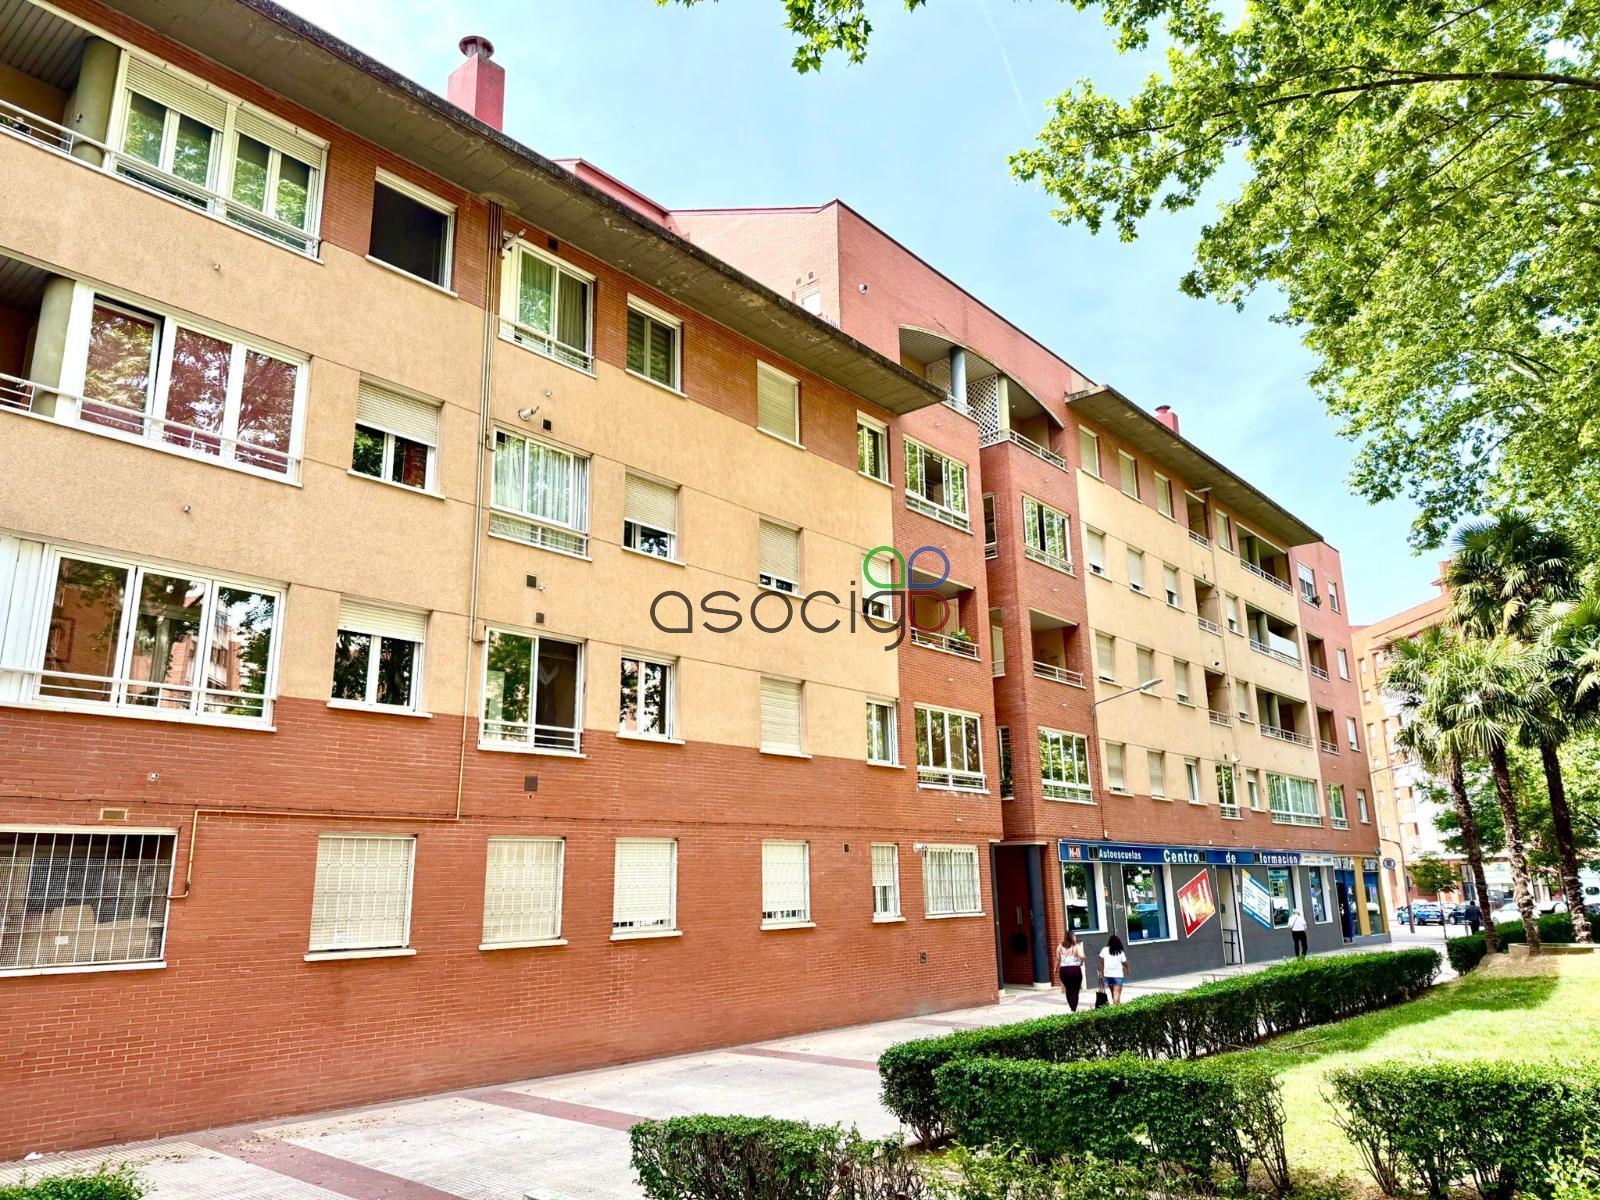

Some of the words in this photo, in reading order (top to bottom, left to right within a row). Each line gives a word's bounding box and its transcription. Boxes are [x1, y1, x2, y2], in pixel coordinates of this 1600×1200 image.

[1099, 849, 1142, 860] Autoescuelas
[1163, 849, 1199, 863] Centro
[1225, 851, 1237, 864] de
